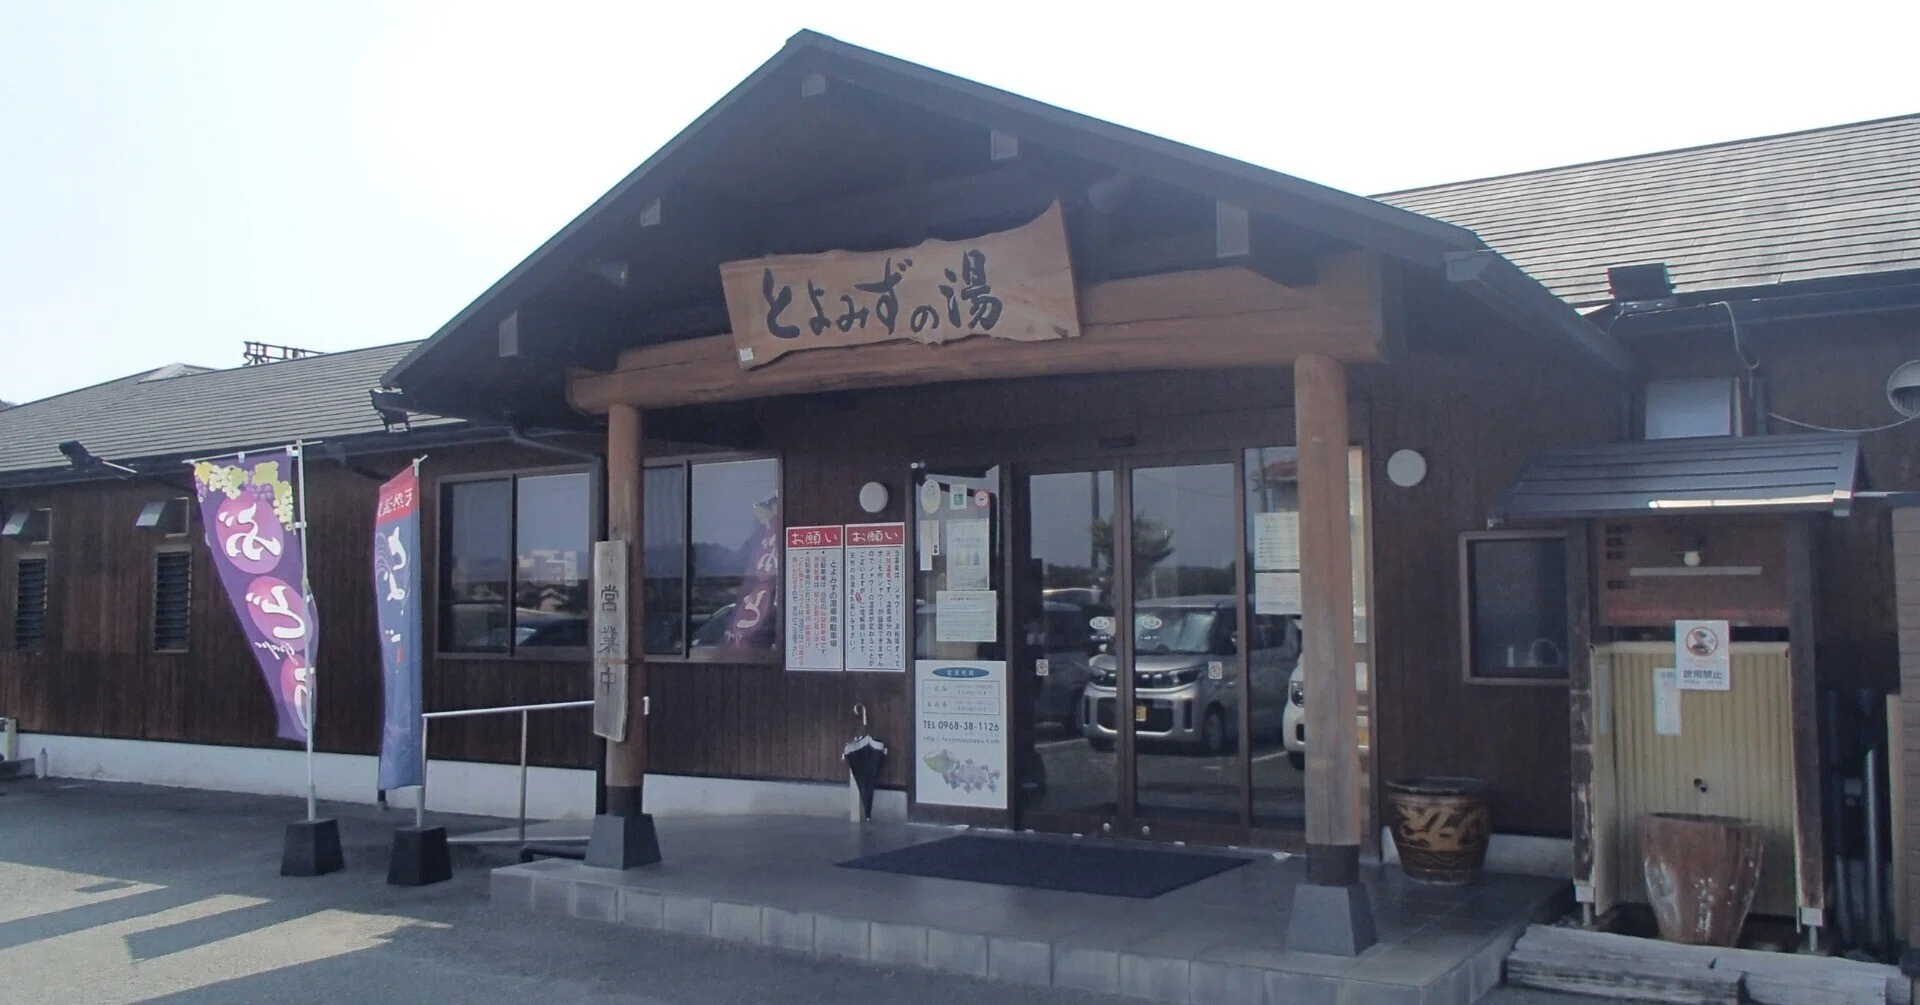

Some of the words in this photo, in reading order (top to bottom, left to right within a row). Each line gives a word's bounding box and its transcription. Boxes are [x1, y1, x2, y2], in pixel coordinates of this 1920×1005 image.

[763, 250, 1003, 339] とよみずの湯
[791, 531, 838, 544] お願い
[851, 530, 899, 543] お願い
[598, 584, 620, 694] 営業中
[923, 720, 936, 729] TEL
[938, 720, 1000, 732] 0968-38-1126
